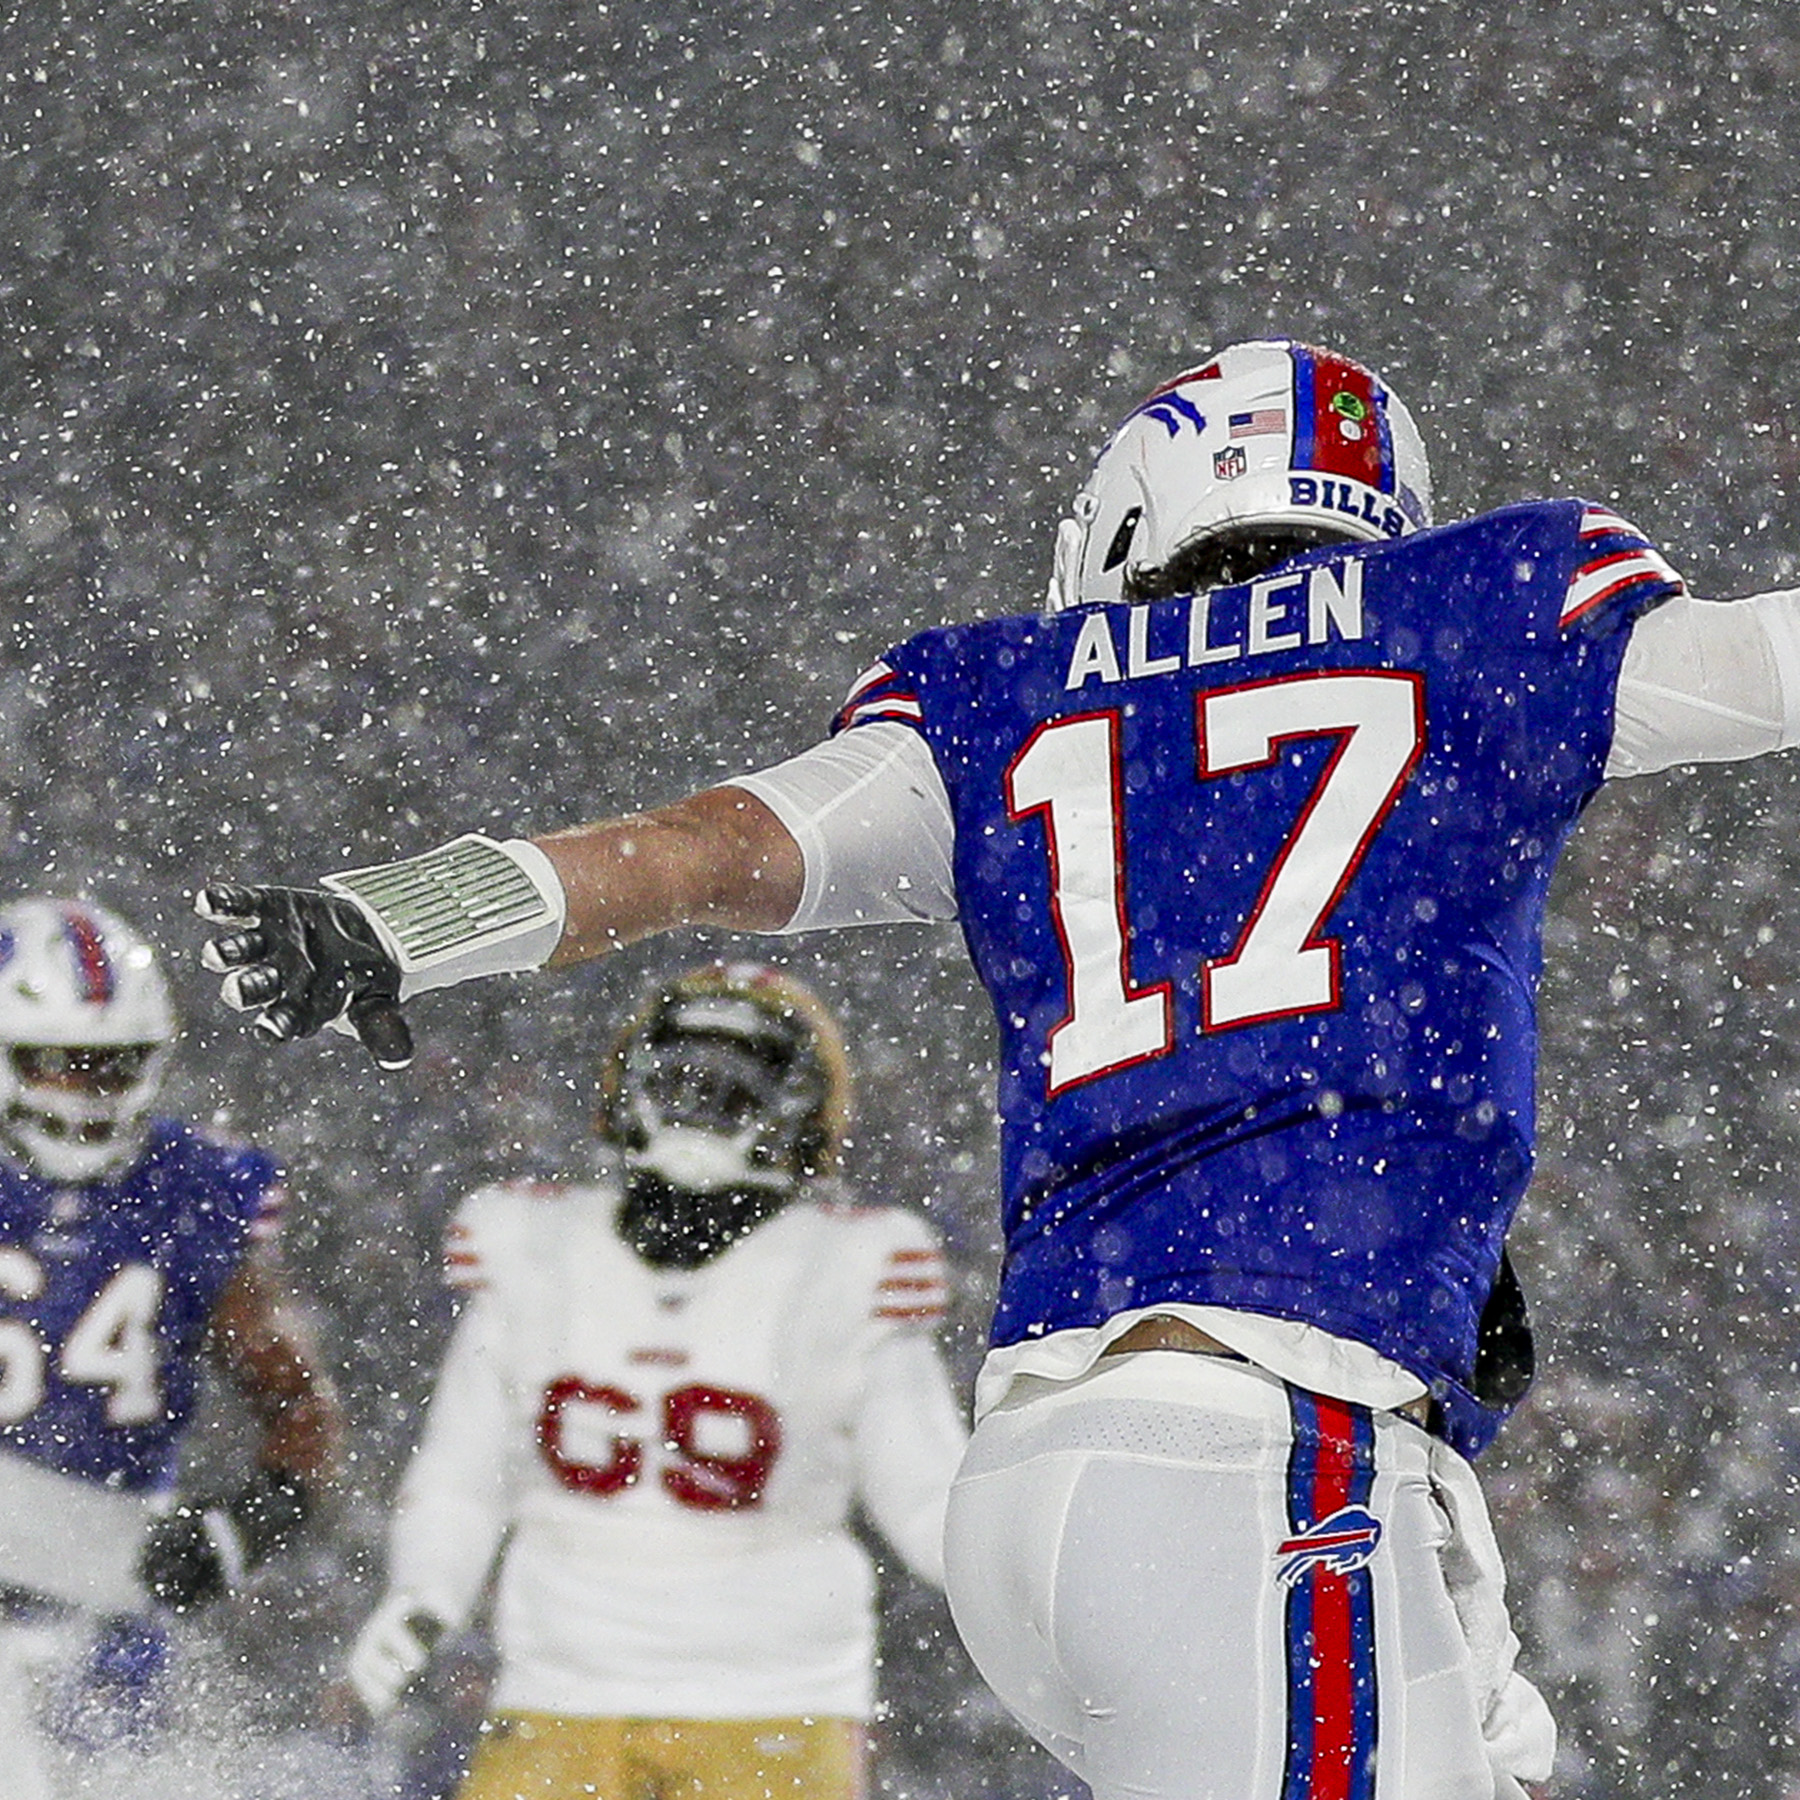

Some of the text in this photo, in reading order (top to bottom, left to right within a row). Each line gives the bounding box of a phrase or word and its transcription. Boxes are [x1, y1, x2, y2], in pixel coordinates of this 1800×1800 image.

[1217, 458, 1244, 477] NFL
[1289, 477, 1405, 537] BILLS
[1065, 556, 1364, 691] ALLEN
[1003, 666, 1427, 1101] 17
